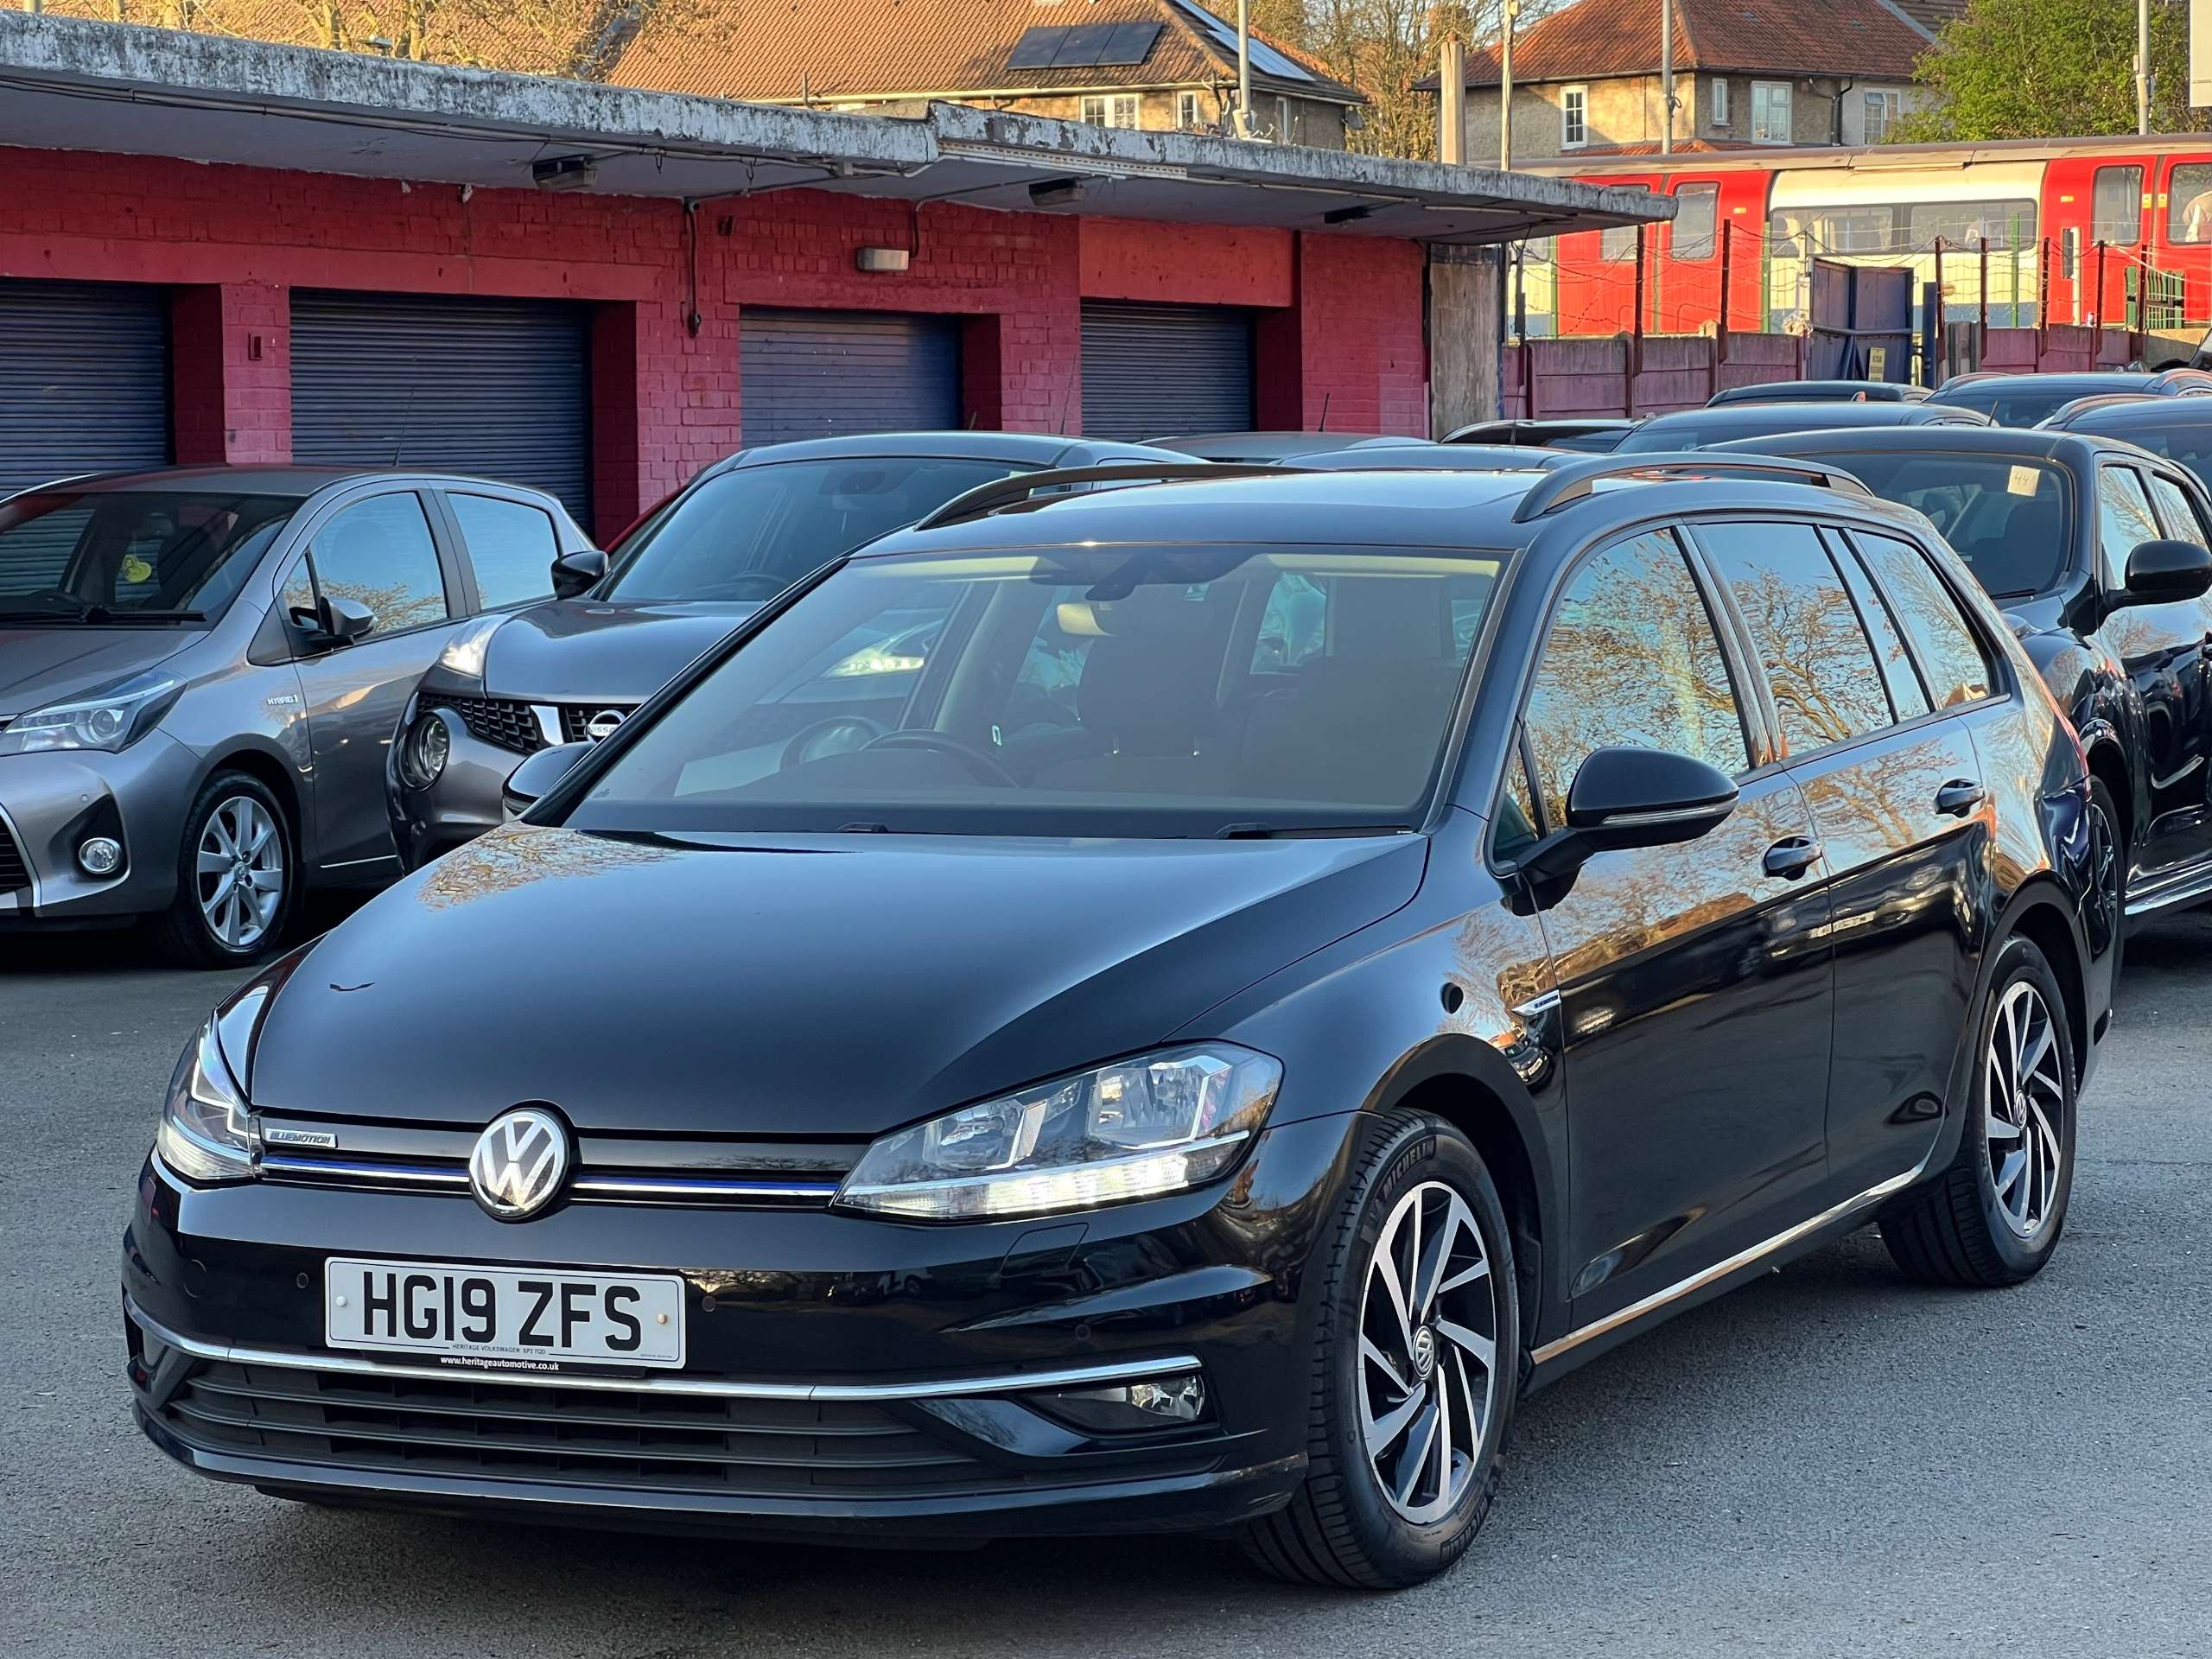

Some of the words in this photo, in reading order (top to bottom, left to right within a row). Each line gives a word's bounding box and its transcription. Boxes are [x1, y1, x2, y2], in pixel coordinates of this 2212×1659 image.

[267, 695, 297, 705] HYBRID
[269, 1130, 331, 1145] BLUEMOTION
[1382, 1140, 1435, 1200] MICHELIN
[363, 1271, 497, 1344] HG19
[517, 1280, 642, 1352] ZFS
[481, 1345, 520, 1354] VOLKSWAGEN
[440, 1356, 559, 1371] www.heritageautomotive.co.uk
